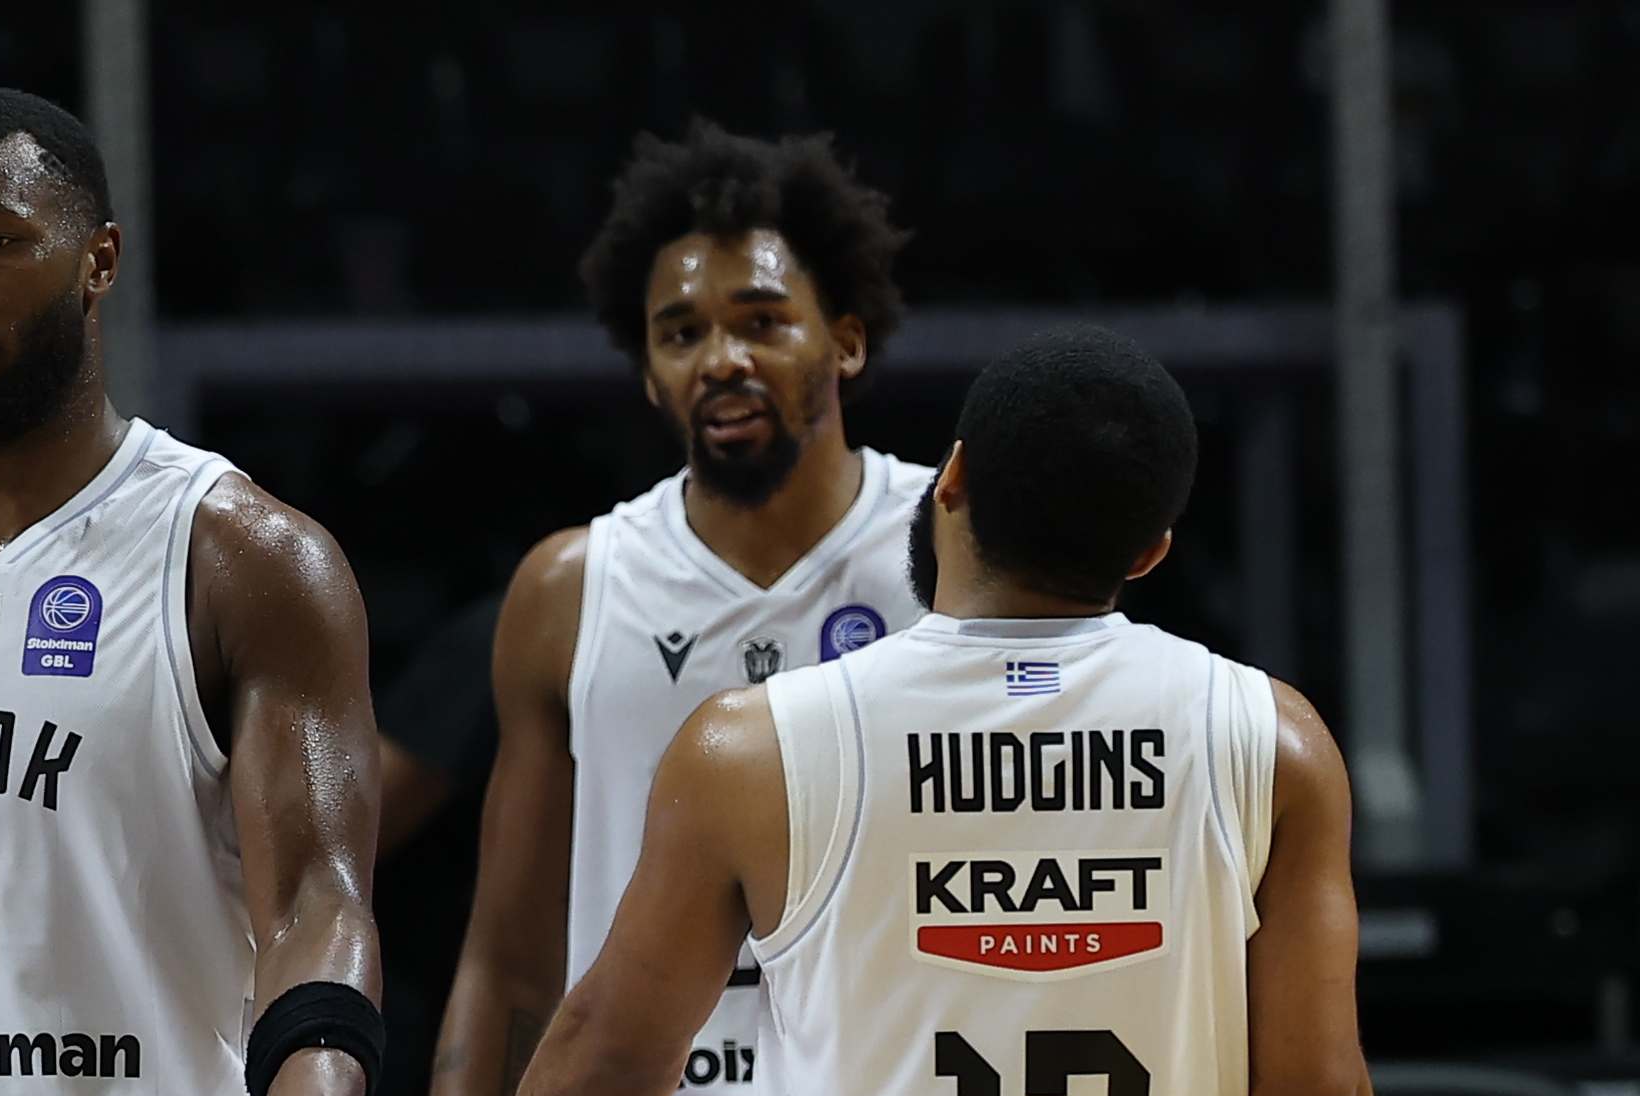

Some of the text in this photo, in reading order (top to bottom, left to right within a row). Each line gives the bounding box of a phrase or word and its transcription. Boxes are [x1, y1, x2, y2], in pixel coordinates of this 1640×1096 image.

[26, 637, 93, 652] Stoiximan
[40, 654, 74, 668] GBL
[906, 729, 1166, 814] HUDGINS
[915, 857, 1163, 914] KRAFT
[979, 932, 1102, 956] PAINTS
